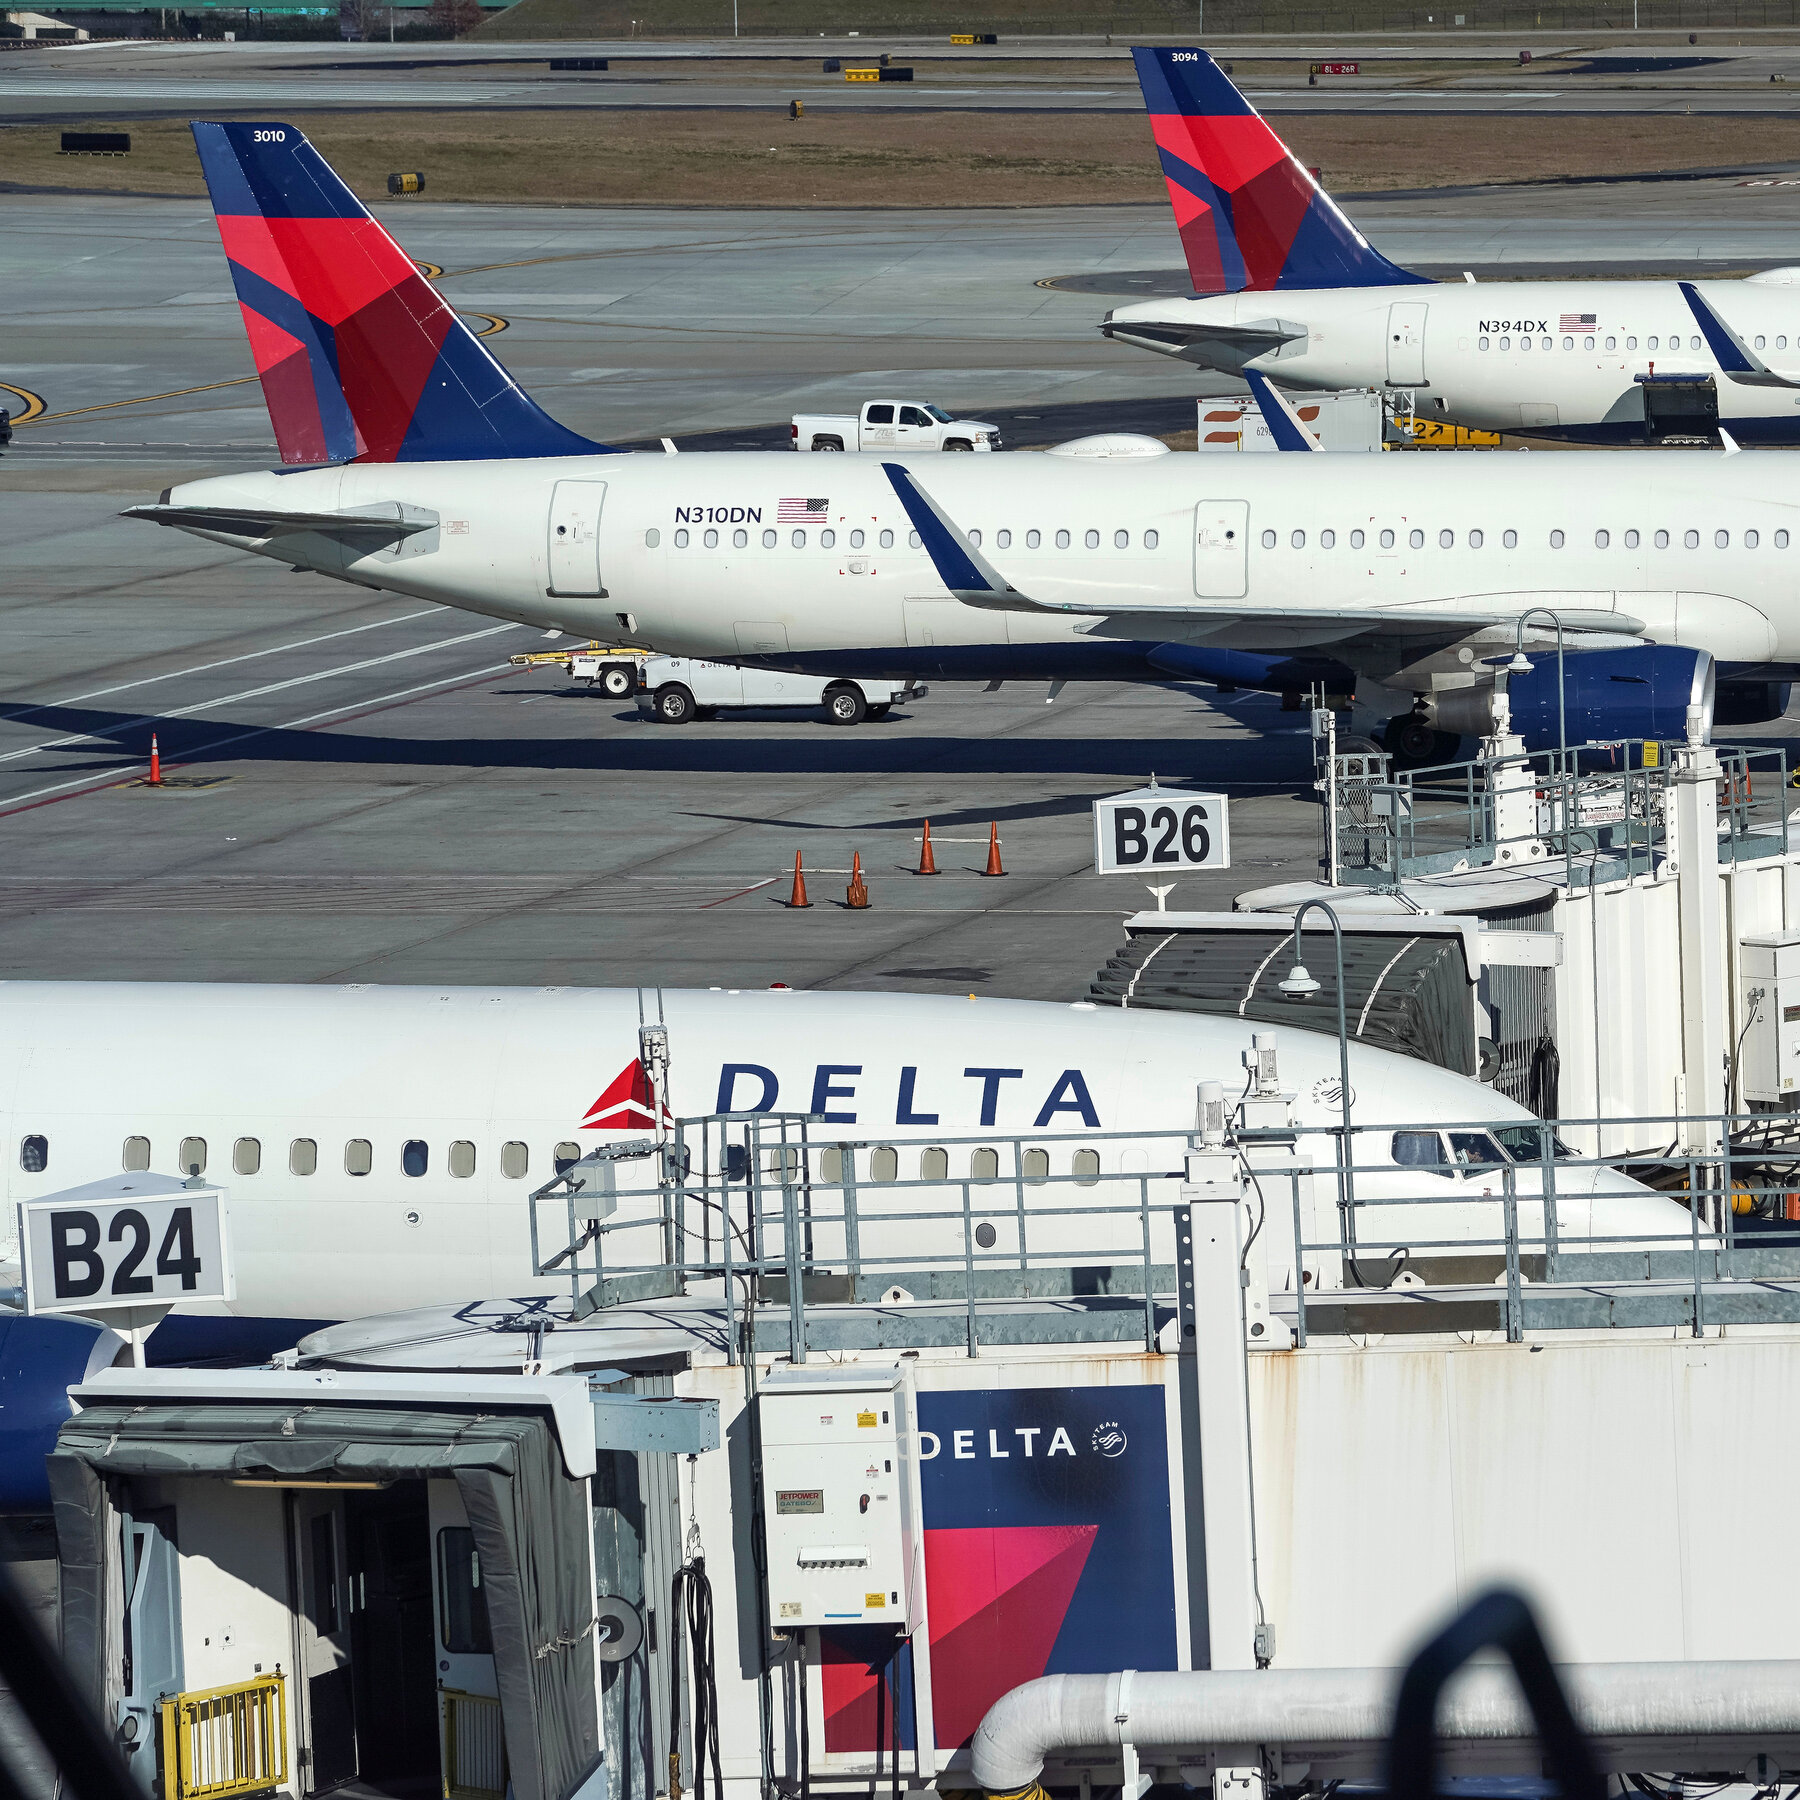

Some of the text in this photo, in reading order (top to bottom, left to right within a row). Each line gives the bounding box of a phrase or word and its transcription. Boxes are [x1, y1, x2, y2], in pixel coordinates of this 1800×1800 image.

[1171, 52, 1198, 62] 3094
[1341, 65, 1355, 74] 26R
[253, 130, 286, 142] 3010
[1479, 320, 1548, 333] N394DX
[675, 506, 762, 524] N310DN
[671, 660, 681, 668] 09
[1114, 804, 1210, 865] B26
[715, 1063, 1102, 1128] DELTA
[50, 1206, 202, 1299] B24
[918, 1426, 1077, 1460] DELTA
[1091, 1421, 1118, 1451] SKYTEAM
[779, 1492, 819, 1500] JETPOWER
